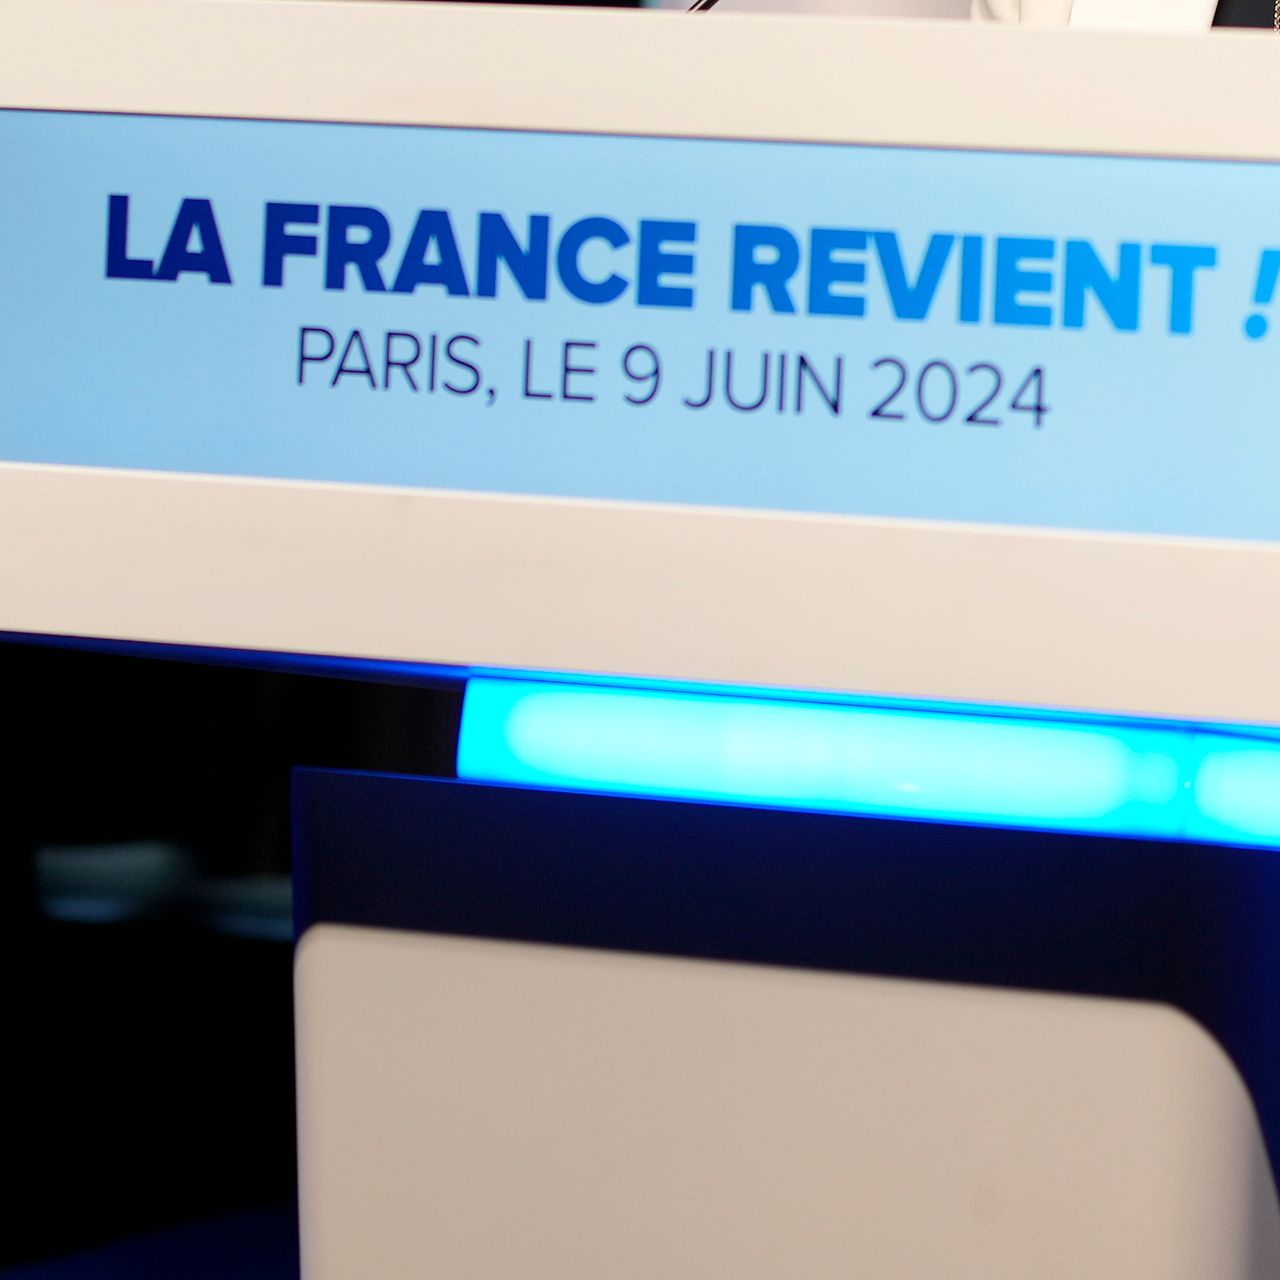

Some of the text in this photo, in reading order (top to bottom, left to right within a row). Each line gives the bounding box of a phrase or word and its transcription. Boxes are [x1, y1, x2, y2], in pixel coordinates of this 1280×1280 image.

[103, 192, 234, 287] LA
[259, 199, 700, 312] FRANCE
[727, 220, 1222, 339] REVIENT
[295, 324, 1050, 430] PARIS, LE 9 JUIN 2024
